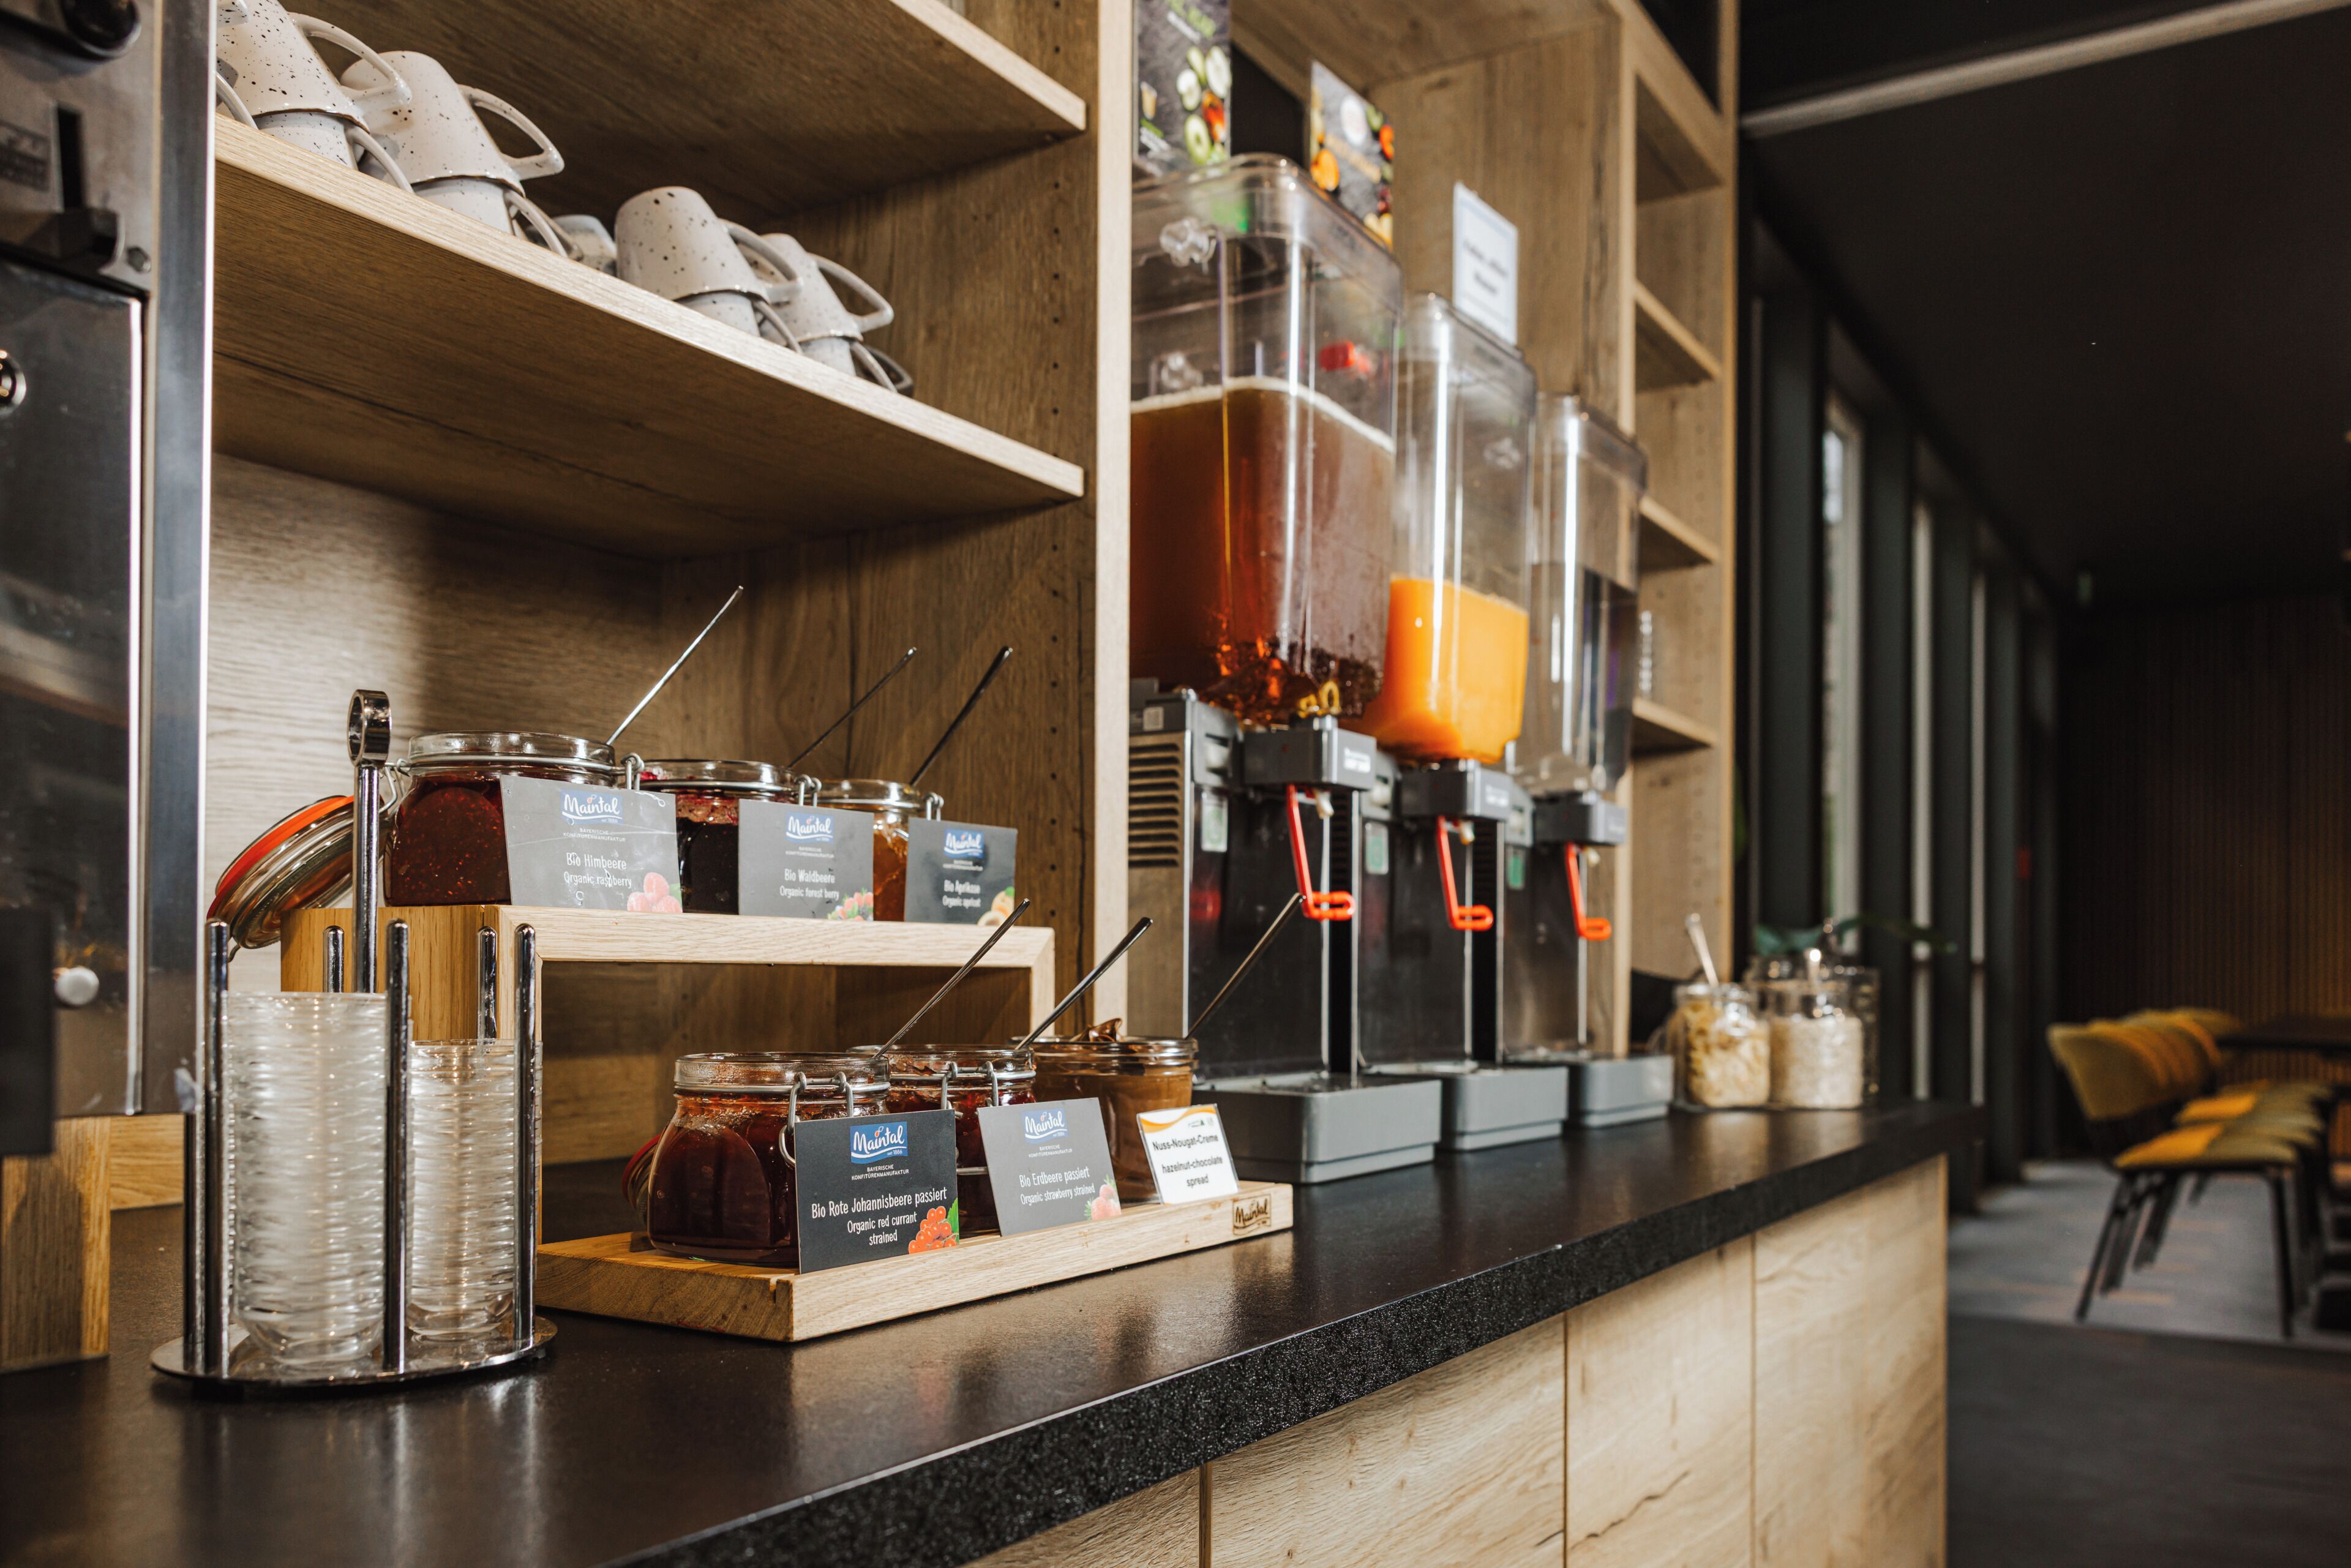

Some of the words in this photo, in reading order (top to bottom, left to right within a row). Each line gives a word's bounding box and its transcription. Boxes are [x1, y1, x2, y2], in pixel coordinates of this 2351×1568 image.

[564, 794, 620, 816] Maintal
[788, 816, 832, 836] Maintal
[945, 832, 982, 850] Maintal
[566, 852, 580, 866] Bio
[584, 853, 627, 869] Himbeere
[563, 871, 594, 886] Organic
[596, 874, 632, 889] raspberry
[784, 868, 796, 882] Bio
[798, 869, 836, 883] Waldbeere
[779, 885, 804, 899] Organic
[805, 887, 823, 898] forest
[824, 888, 839, 901] berry
[943, 879, 954, 892] Bio
[1025, 1111, 1065, 1135] Maintal
[853, 1125, 905, 1154] Maintal
[1152, 1135, 1218, 1151] Nuss-Nougat-Creme
[851, 1169, 909, 1180] KONFITÜRENMANUFAKTUR
[1161, 1157, 1223, 1174] hazelnut-chocolate
[1019, 1174, 1031, 1188] Bio
[1032, 1171, 1063, 1186] Erdbeere
[1064, 1166, 1090, 1184] passiert
[1187, 1173, 1209, 1189] spread
[812, 1202, 826, 1218] Bio
[829, 1199, 849, 1217] Rote
[851, 1194, 912, 1213] Johannisbeere
[915, 1187, 948, 1207] passiert
[1020, 1191, 1043, 1206] Organic
[1044, 1187, 1073, 1201] strawberry
[1073, 1183, 1095, 1196] strained
[1235, 1198, 1268, 1226] Maintal
[847, 1220, 876, 1234] Organic
[878, 1215, 890, 1228] red
[891, 1211, 917, 1226] currant
[869, 1229, 898, 1245] strained
